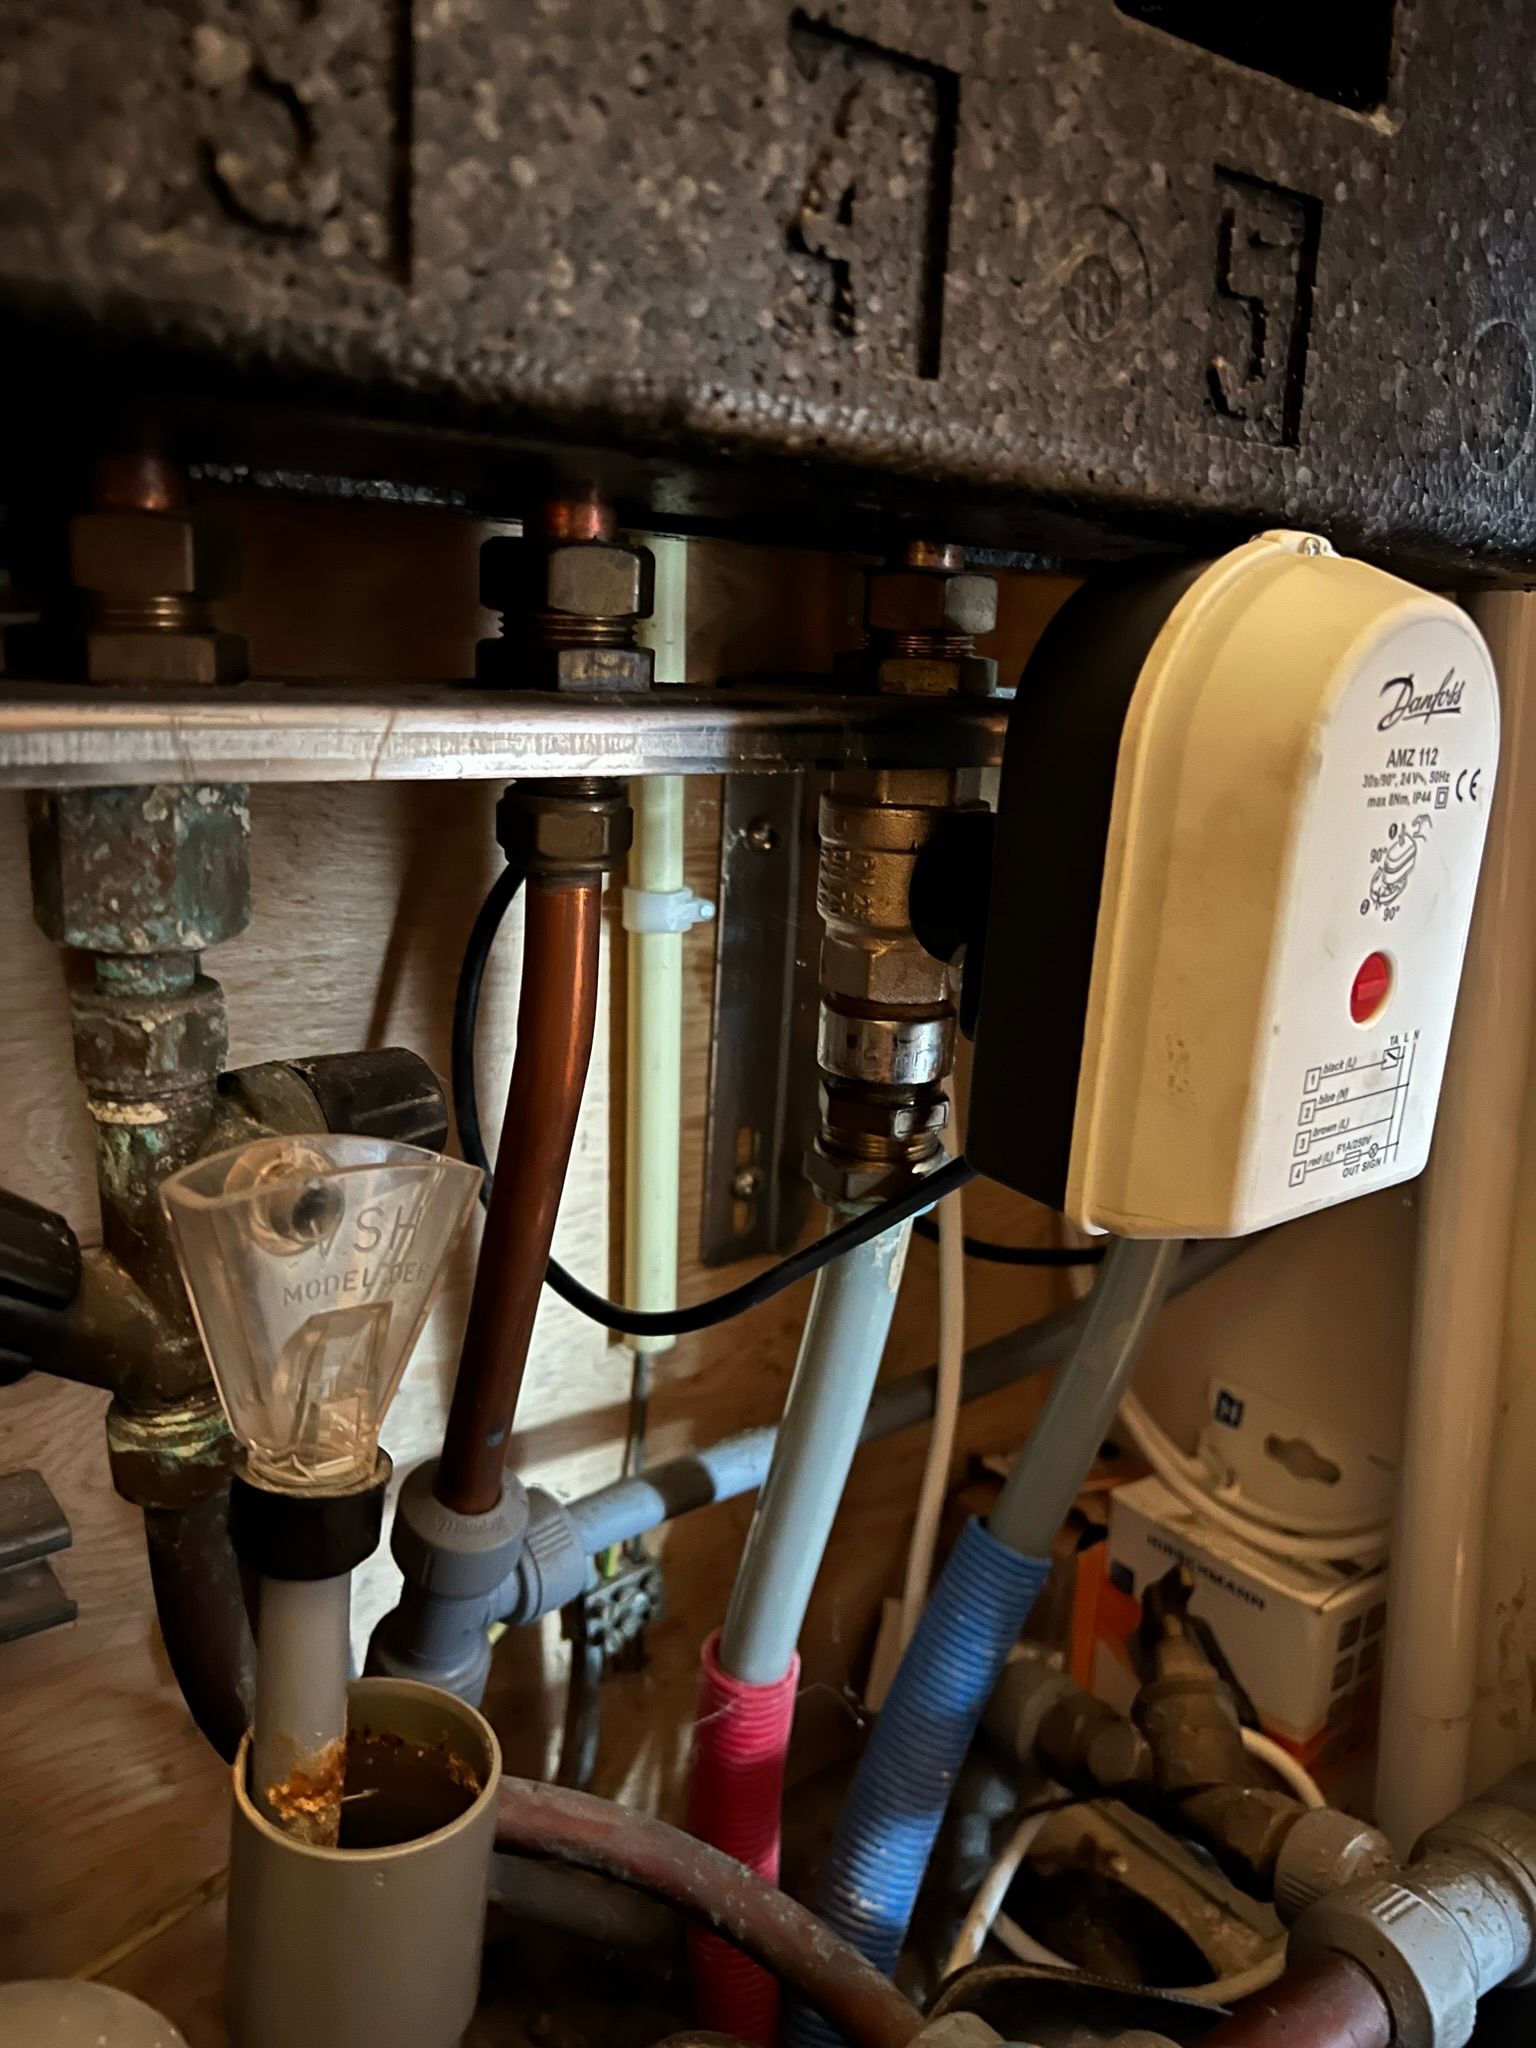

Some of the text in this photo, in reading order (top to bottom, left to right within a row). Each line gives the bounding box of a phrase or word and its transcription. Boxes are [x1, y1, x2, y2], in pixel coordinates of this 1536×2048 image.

[1377, 667, 1466, 732] Danfoss
[1386, 746, 1439, 768] AMZ 112
[1429, 770, 1451, 784] 50Hz
[1367, 796, 1387, 808] max
[1412, 791, 1432, 804] IP44
[1322, 1059, 1345, 1074] black
[1304, 1106, 1311, 1119] 2
[1318, 1093, 1336, 1106] blue
[1299, 1137, 1306, 1150] 3
[1312, 1123, 1338, 1137] brown
[1308, 1155, 1322, 1167] red
[1342, 1157, 1382, 1178] OUT SIGN
[283, 1266, 377, 1307] MODEL
